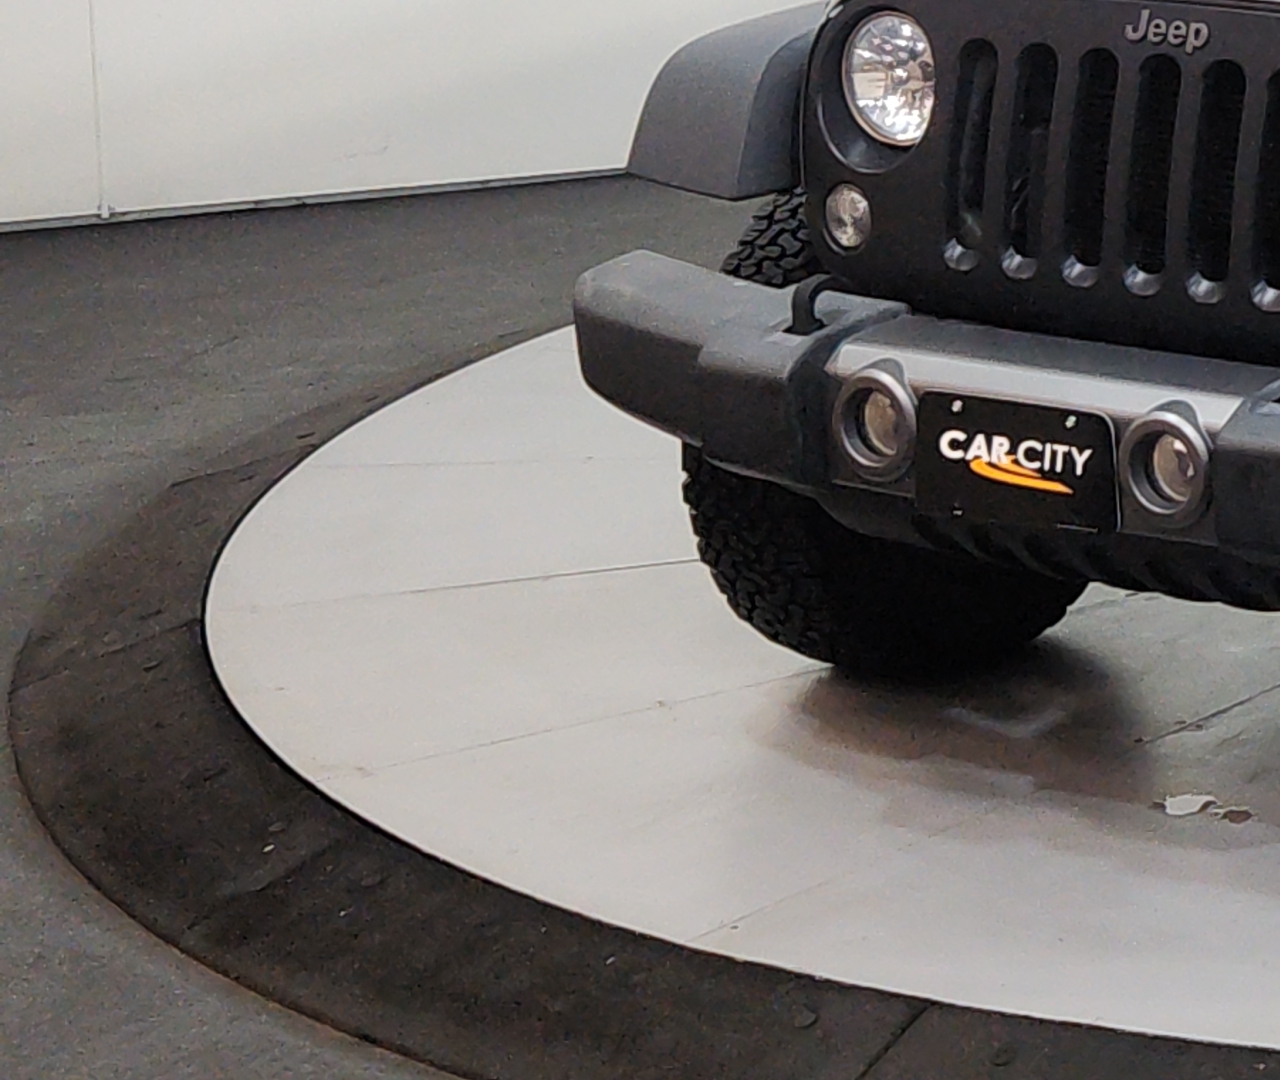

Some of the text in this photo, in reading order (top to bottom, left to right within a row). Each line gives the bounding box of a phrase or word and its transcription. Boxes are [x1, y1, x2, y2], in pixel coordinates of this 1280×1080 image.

[1124, 8, 1209, 54] Jeep
[939, 430, 1092, 476] CAR CITY
